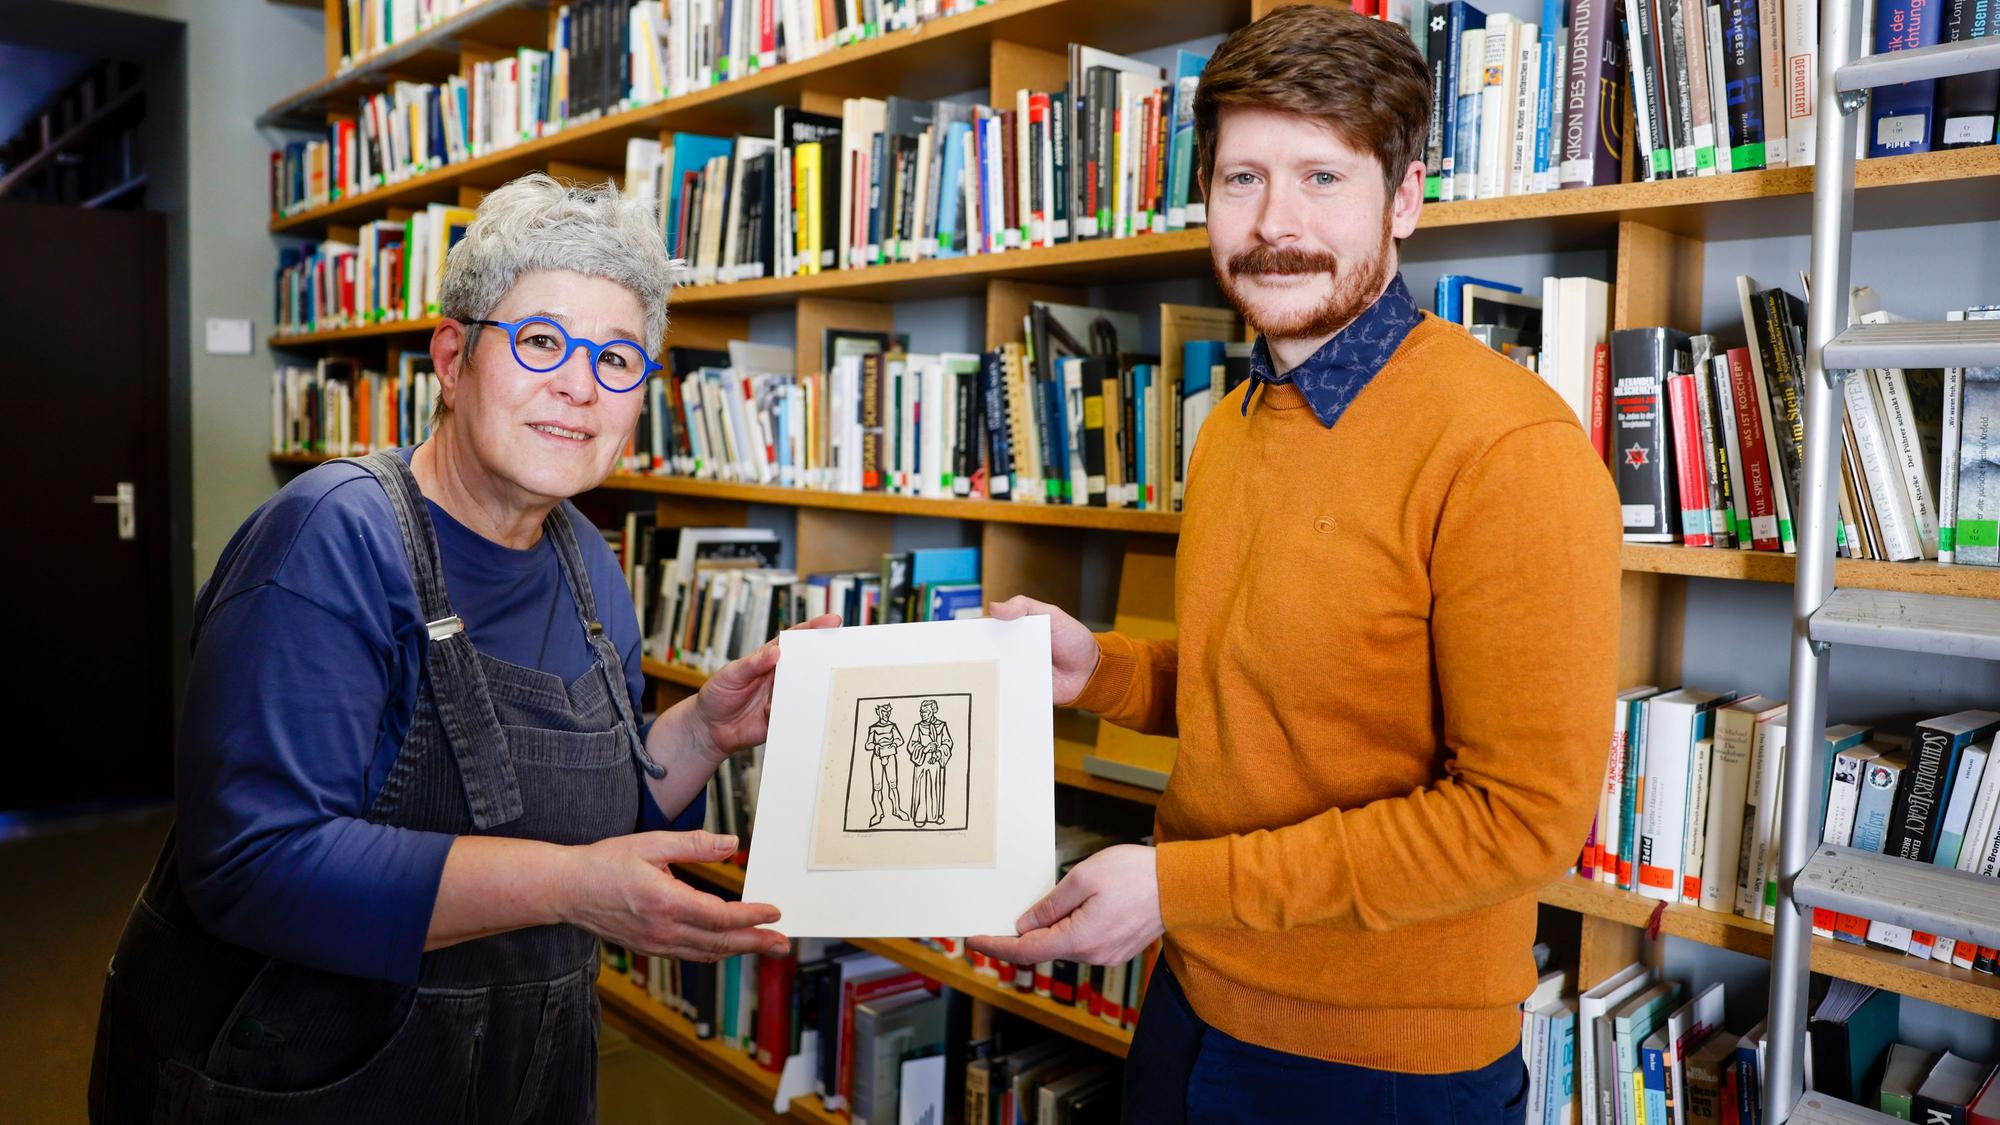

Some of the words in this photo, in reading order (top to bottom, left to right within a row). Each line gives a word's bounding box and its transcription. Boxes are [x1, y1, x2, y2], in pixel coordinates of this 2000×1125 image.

[1891, 9, 1905, 32] der
[1734, 9, 1745, 65] BAMBERG
[1571, 81, 1586, 109] DES
[1795, 58, 1806, 114] DEPORTIERT
[1567, 113, 1582, 160] XIKON
[1886, 141, 1911, 149] PIPER
[1596, 350, 1606, 365] THE
[1618, 377, 1655, 387] ALEXANDER
[1734, 361, 1748, 410] KOSCHER?
[1888, 381, 1896, 395] den
[1785, 387, 1799, 421] Stein
[1847, 372, 1867, 429] SEPTEM
[1892, 396, 1905, 426] schenkt
[1741, 413, 1750, 426] IST
[1980, 416, 1989, 440] Krefeld
[1744, 429, 1753, 448] WAS
[1900, 428, 1911, 453] Führer
[1719, 448, 1727, 463] Nacht
[1907, 454, 1915, 468] Der
[1752, 461, 1764, 496] SPIEGEL
[1913, 475, 1925, 501] Starke
[1977, 471, 1986, 498] jüdische
[1758, 498, 1767, 516] AUL
[1610, 731, 1619, 781] ANGESICHT
[1913, 732, 1948, 797] SCHINDLER'S
[1618, 766, 1626, 784] DES
[1609, 782, 1616, 795] IM
[1905, 793, 1935, 836] LEGACY
[1910, 839, 1922, 861] ELINO
